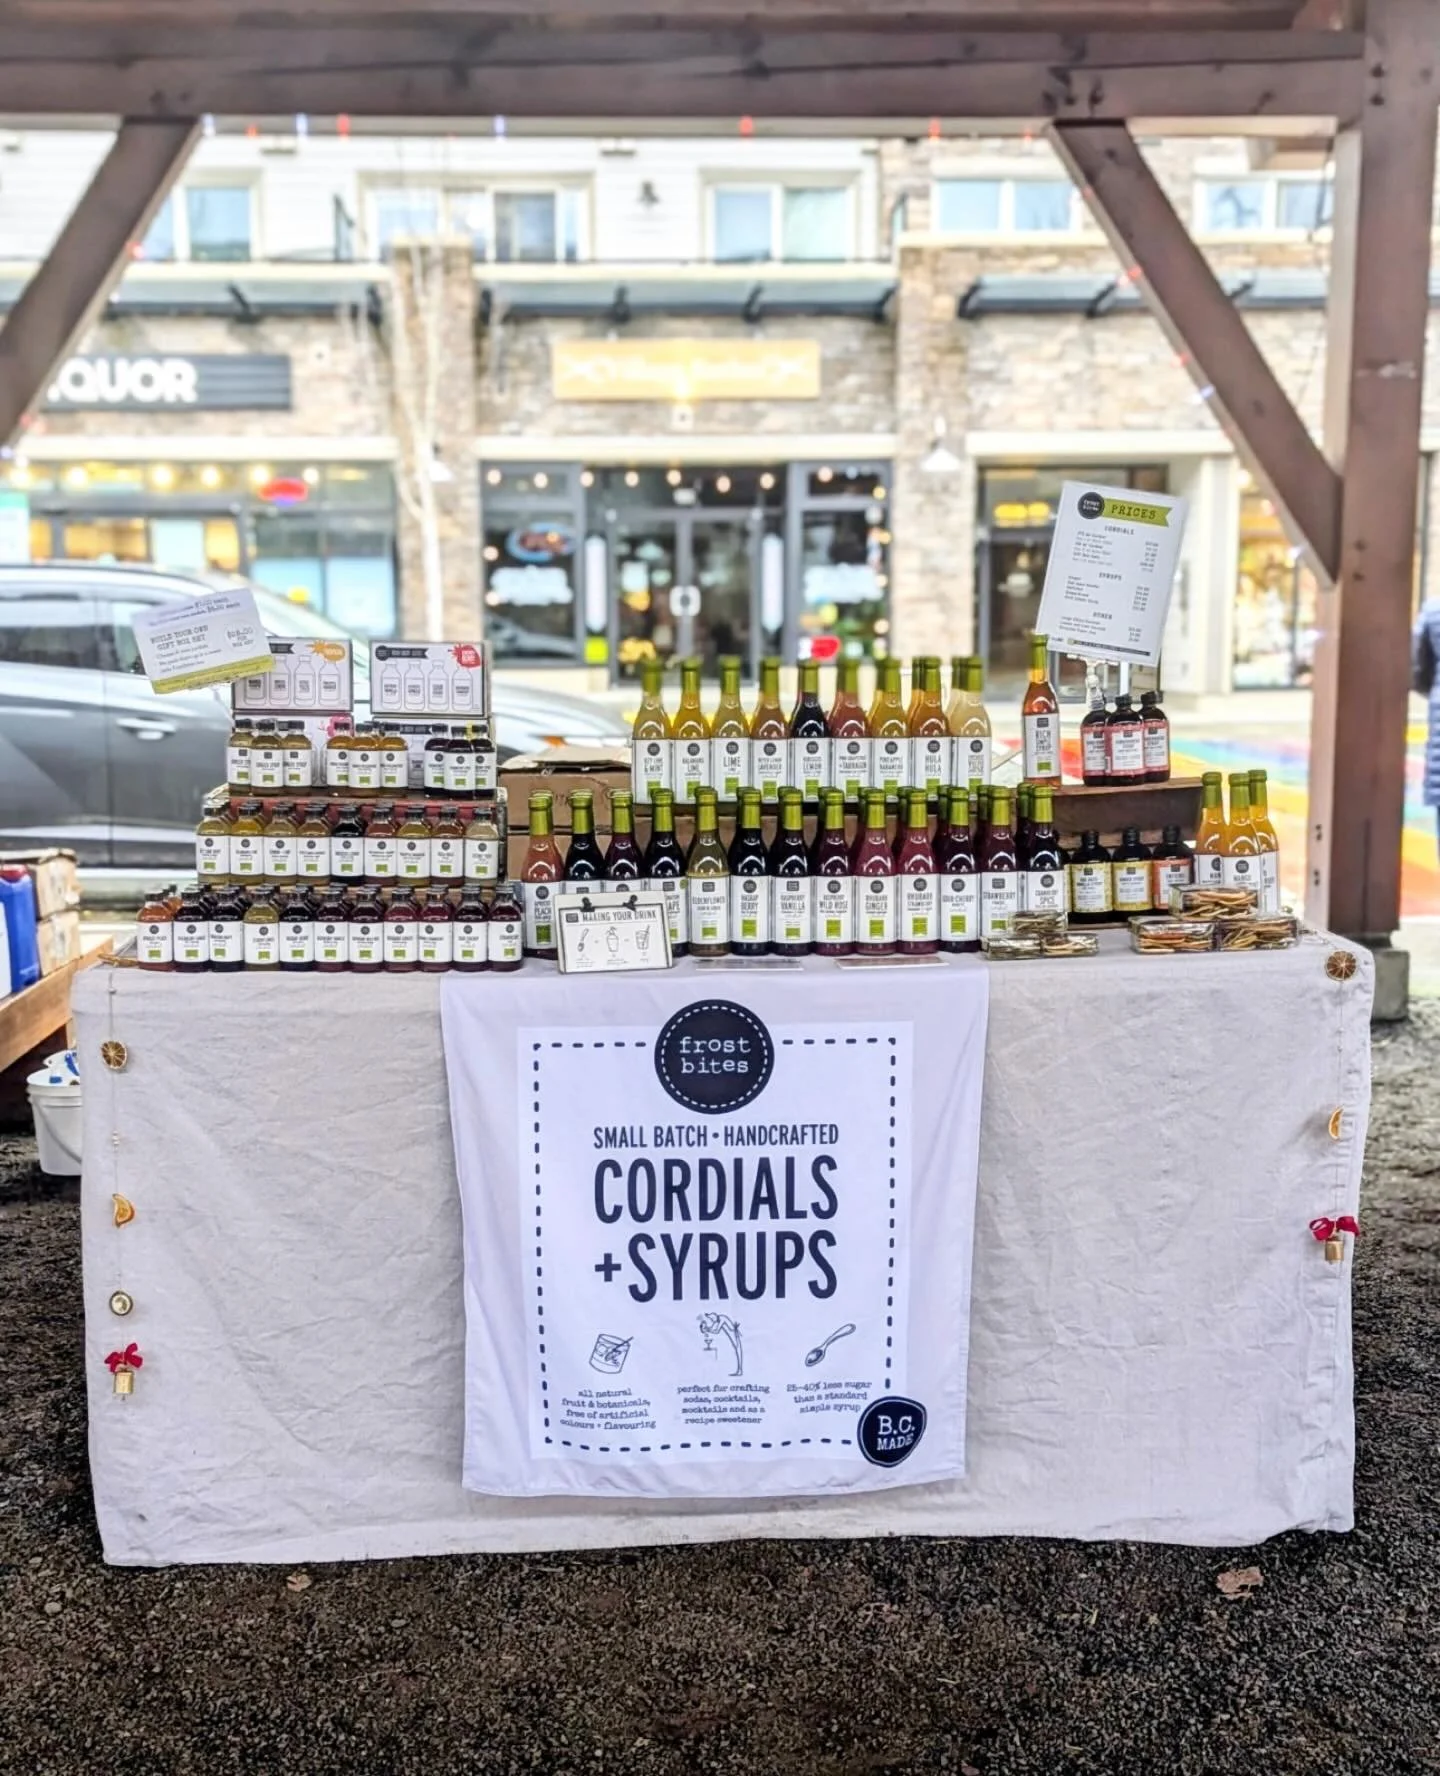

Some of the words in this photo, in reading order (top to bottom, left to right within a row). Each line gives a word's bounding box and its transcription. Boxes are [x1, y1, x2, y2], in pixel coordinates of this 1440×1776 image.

[48, 358, 197, 403] QUOR
[1111, 504, 1157, 520] PRICES
[174, 629, 193, 638] YOUR
[157, 642, 175, 651] GIFT
[723, 757, 741, 767] LIME
[925, 755, 941, 763] HULA
[925, 764, 941, 773] HULA
[692, 896, 725, 904] ELDERFLOWER
[983, 892, 1016, 900] STRAWBERRY
[741, 902, 759, 910] BERRY
[781, 902, 806, 910] VANILLA
[819, 901, 833, 909] WILD
[835, 901, 848, 909] ROSE
[865, 902, 888, 910] GINGER
[535, 907, 552, 916] PEACH
[582, 912, 611, 922] MAKING
[613, 911, 632, 921] YOUR
[634, 910, 657, 920] DRINK
[679, 1036, 751, 1053] frost
[681, 1057, 749, 1074] bites
[593, 1126, 648, 1149] SMALL
[653, 1125, 708, 1148] BATCH
[723, 1124, 839, 1146] HANDCRAFTED
[594, 1155, 838, 1224] CORDIALS
[594, 1229, 837, 1303] +SYRUPS
[677, 1385, 710, 1394] perfect
[729, 1384, 770, 1394] crafting
[823, 1382, 843, 1390] less
[844, 1382, 872, 1390] sugar
[578, 1389, 594, 1398] all
[595, 1387, 632, 1398] natural
[793, 1395, 815, 1403] than
[824, 1391, 867, 1400] standard
[561, 1398, 586, 1407] fruit
[596, 1398, 651, 1408] botanicals,
[683, 1396, 711, 1404] sodas,
[713, 1395, 760, 1403] cocktails,
[799, 1403, 832, 1413] simple
[833, 1403, 861, 1413] syrup
[566, 1409, 585, 1417] free
[587, 1411, 597, 1419] of
[599, 1409, 649, 1419] artificial
[560, 1419, 594, 1428] colours
[604, 1421, 656, 1430] flavouring
[685, 1417, 715, 1425] recipe
[717, 1416, 762, 1424] sweetener
[877, 1414, 915, 1435] B.C.
[877, 1433, 914, 1451] MADE
